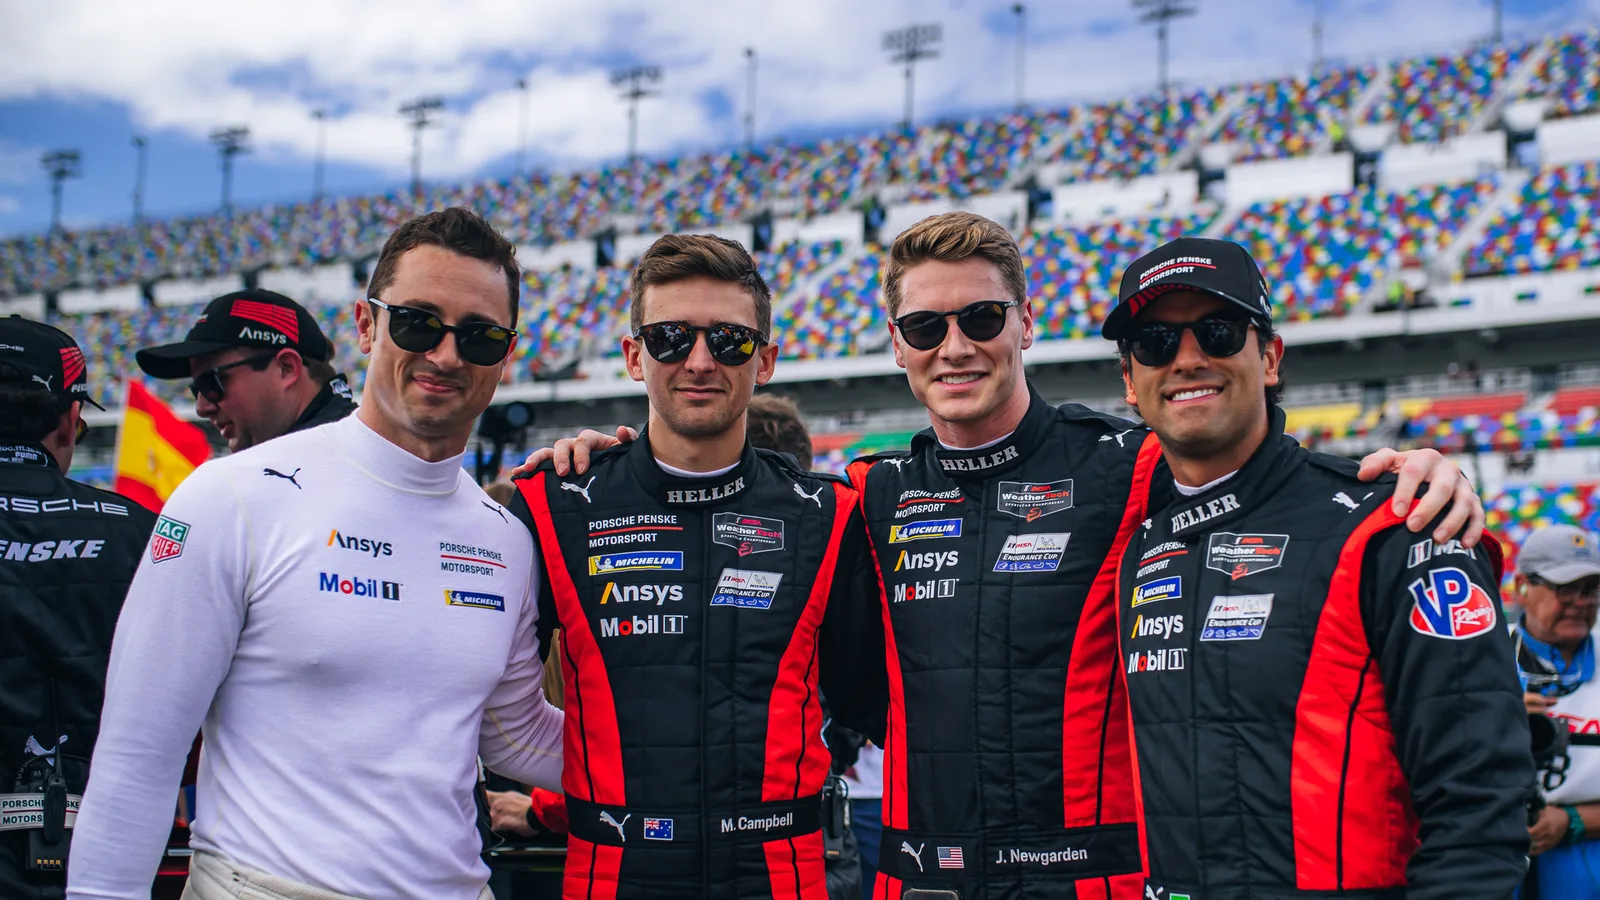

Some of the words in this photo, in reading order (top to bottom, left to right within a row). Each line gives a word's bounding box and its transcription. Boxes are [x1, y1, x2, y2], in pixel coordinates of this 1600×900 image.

[1140, 258, 1176, 279] PORSCHE
[1177, 256, 1212, 265] PENSKE
[1139, 266, 1195, 290] MOTORSPORT
[238, 326, 287, 345] Ansys
[940, 445, 1019, 472] HELLER
[667, 476, 745, 503] HELLER
[1002, 491, 1070, 500] WeatherTech
[895, 504, 946, 518] MOTORSPORT
[1172, 493, 1240, 534] HELLER
[156, 520, 184, 540] TAG
[588, 515, 636, 531] PORSCHE
[638, 514, 677, 524] PENSKE
[908, 525, 955, 536] MICHELIN
[327, 529, 393, 558] Ansys
[588, 533, 658, 548] MOTORSPORT
[440, 542, 477, 556] PORSCHE
[478, 548, 502, 562] PENSKE
[615, 557, 675, 567] MICHELIN
[894, 549, 958, 572] Ansys
[1043, 552, 1058, 560] CUP
[441, 562, 494, 576] MOTORSPORT
[320, 572, 377, 598] Mobil
[600, 582, 684, 606] Ansys
[756, 590, 770, 598] CUP
[894, 580, 935, 603] Mobil
[1144, 584, 1176, 598] MICHELIN
[464, 596, 502, 606] MICHELIN
[1408, 567, 1472, 637] VP
[600, 616, 658, 638] Mobil
[1131, 614, 1184, 639] Ansys
[1128, 649, 1166, 674] Mobil
[2, 815, 43, 824] MOTORS
[721, 818, 736, 833] M.
[738, 812, 793, 832] Campbell
[996, 850, 1006, 864] J.
[1010, 847, 1088, 865] Newgarden
